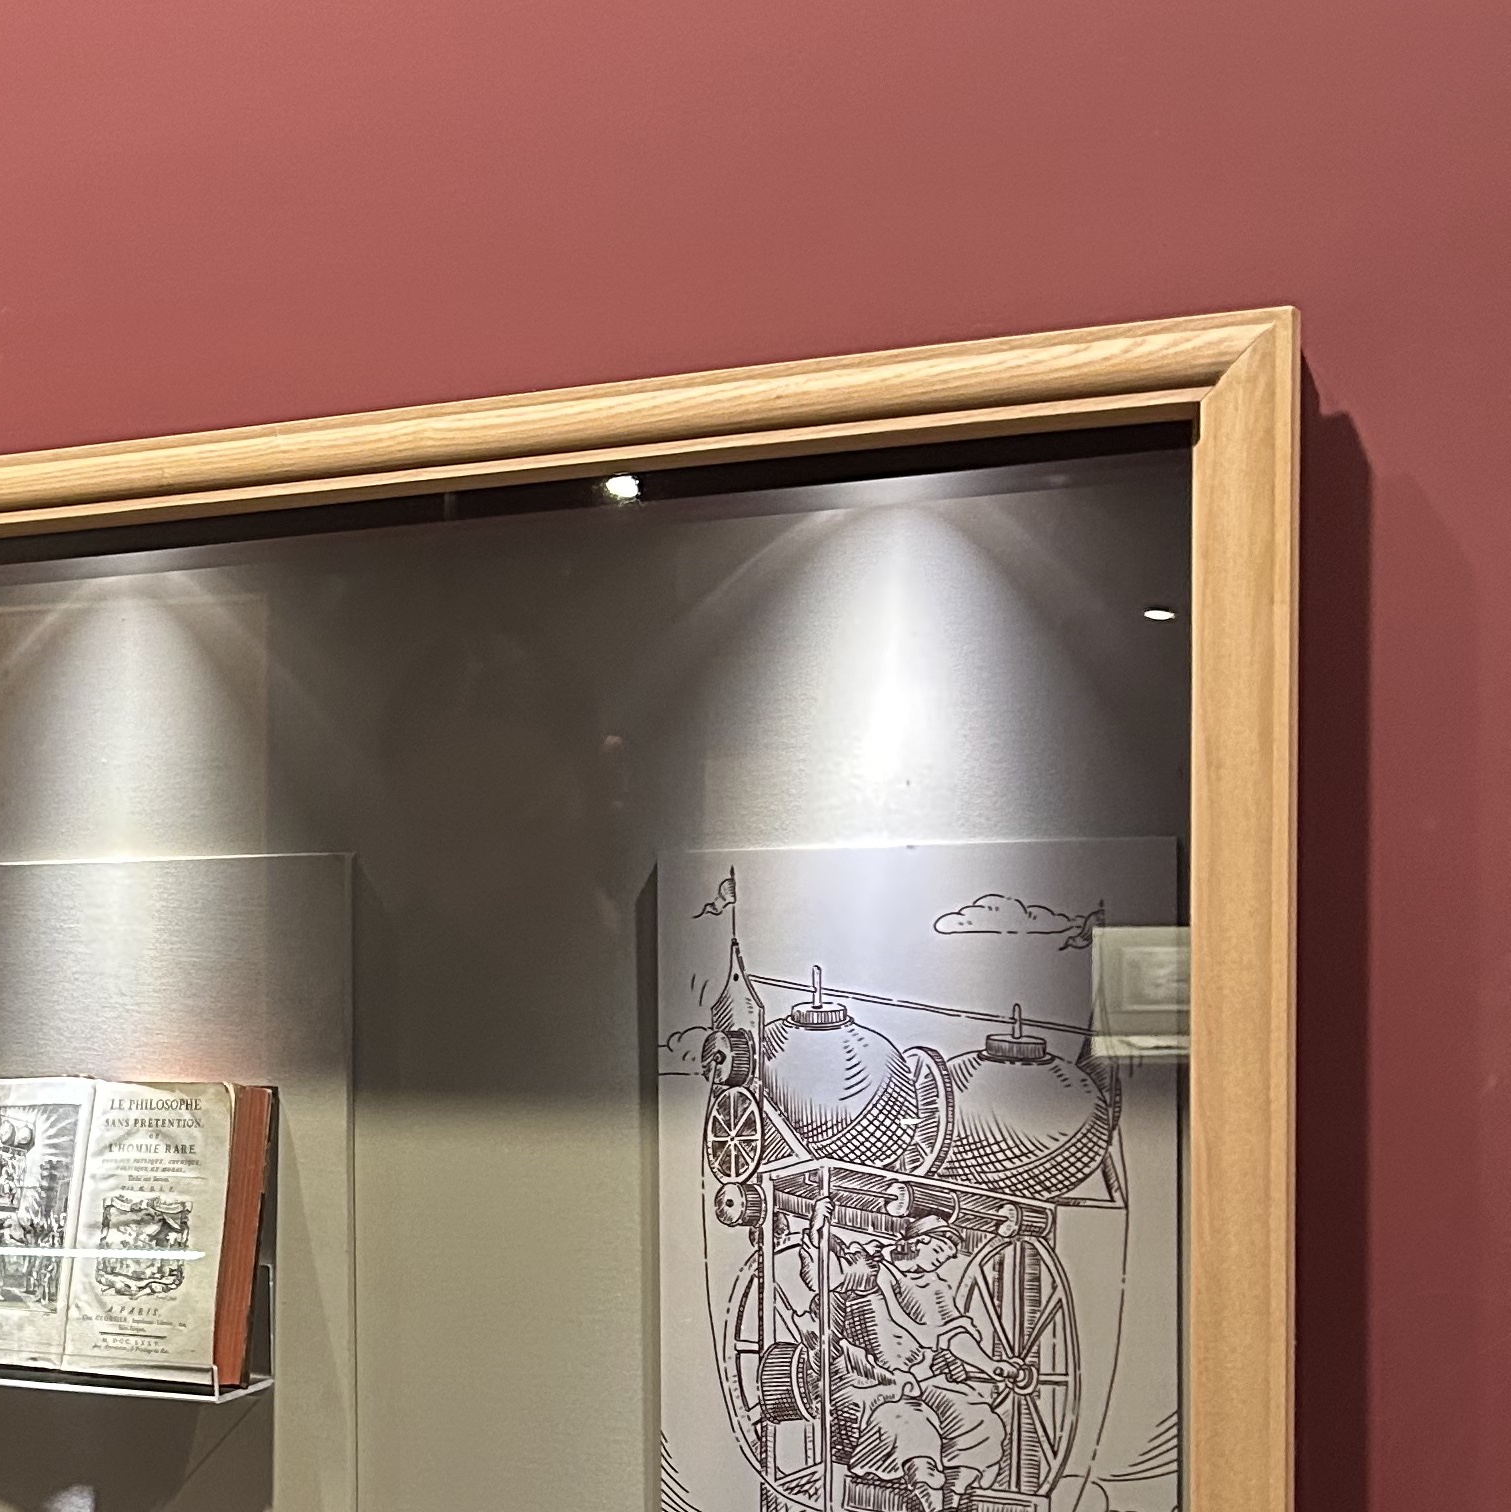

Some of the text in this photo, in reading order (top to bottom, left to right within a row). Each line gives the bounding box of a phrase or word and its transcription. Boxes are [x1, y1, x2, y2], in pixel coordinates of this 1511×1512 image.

[110, 1098, 202, 1110] LE PHILOSOPHE
[105, 1118, 129, 1128] SANS
